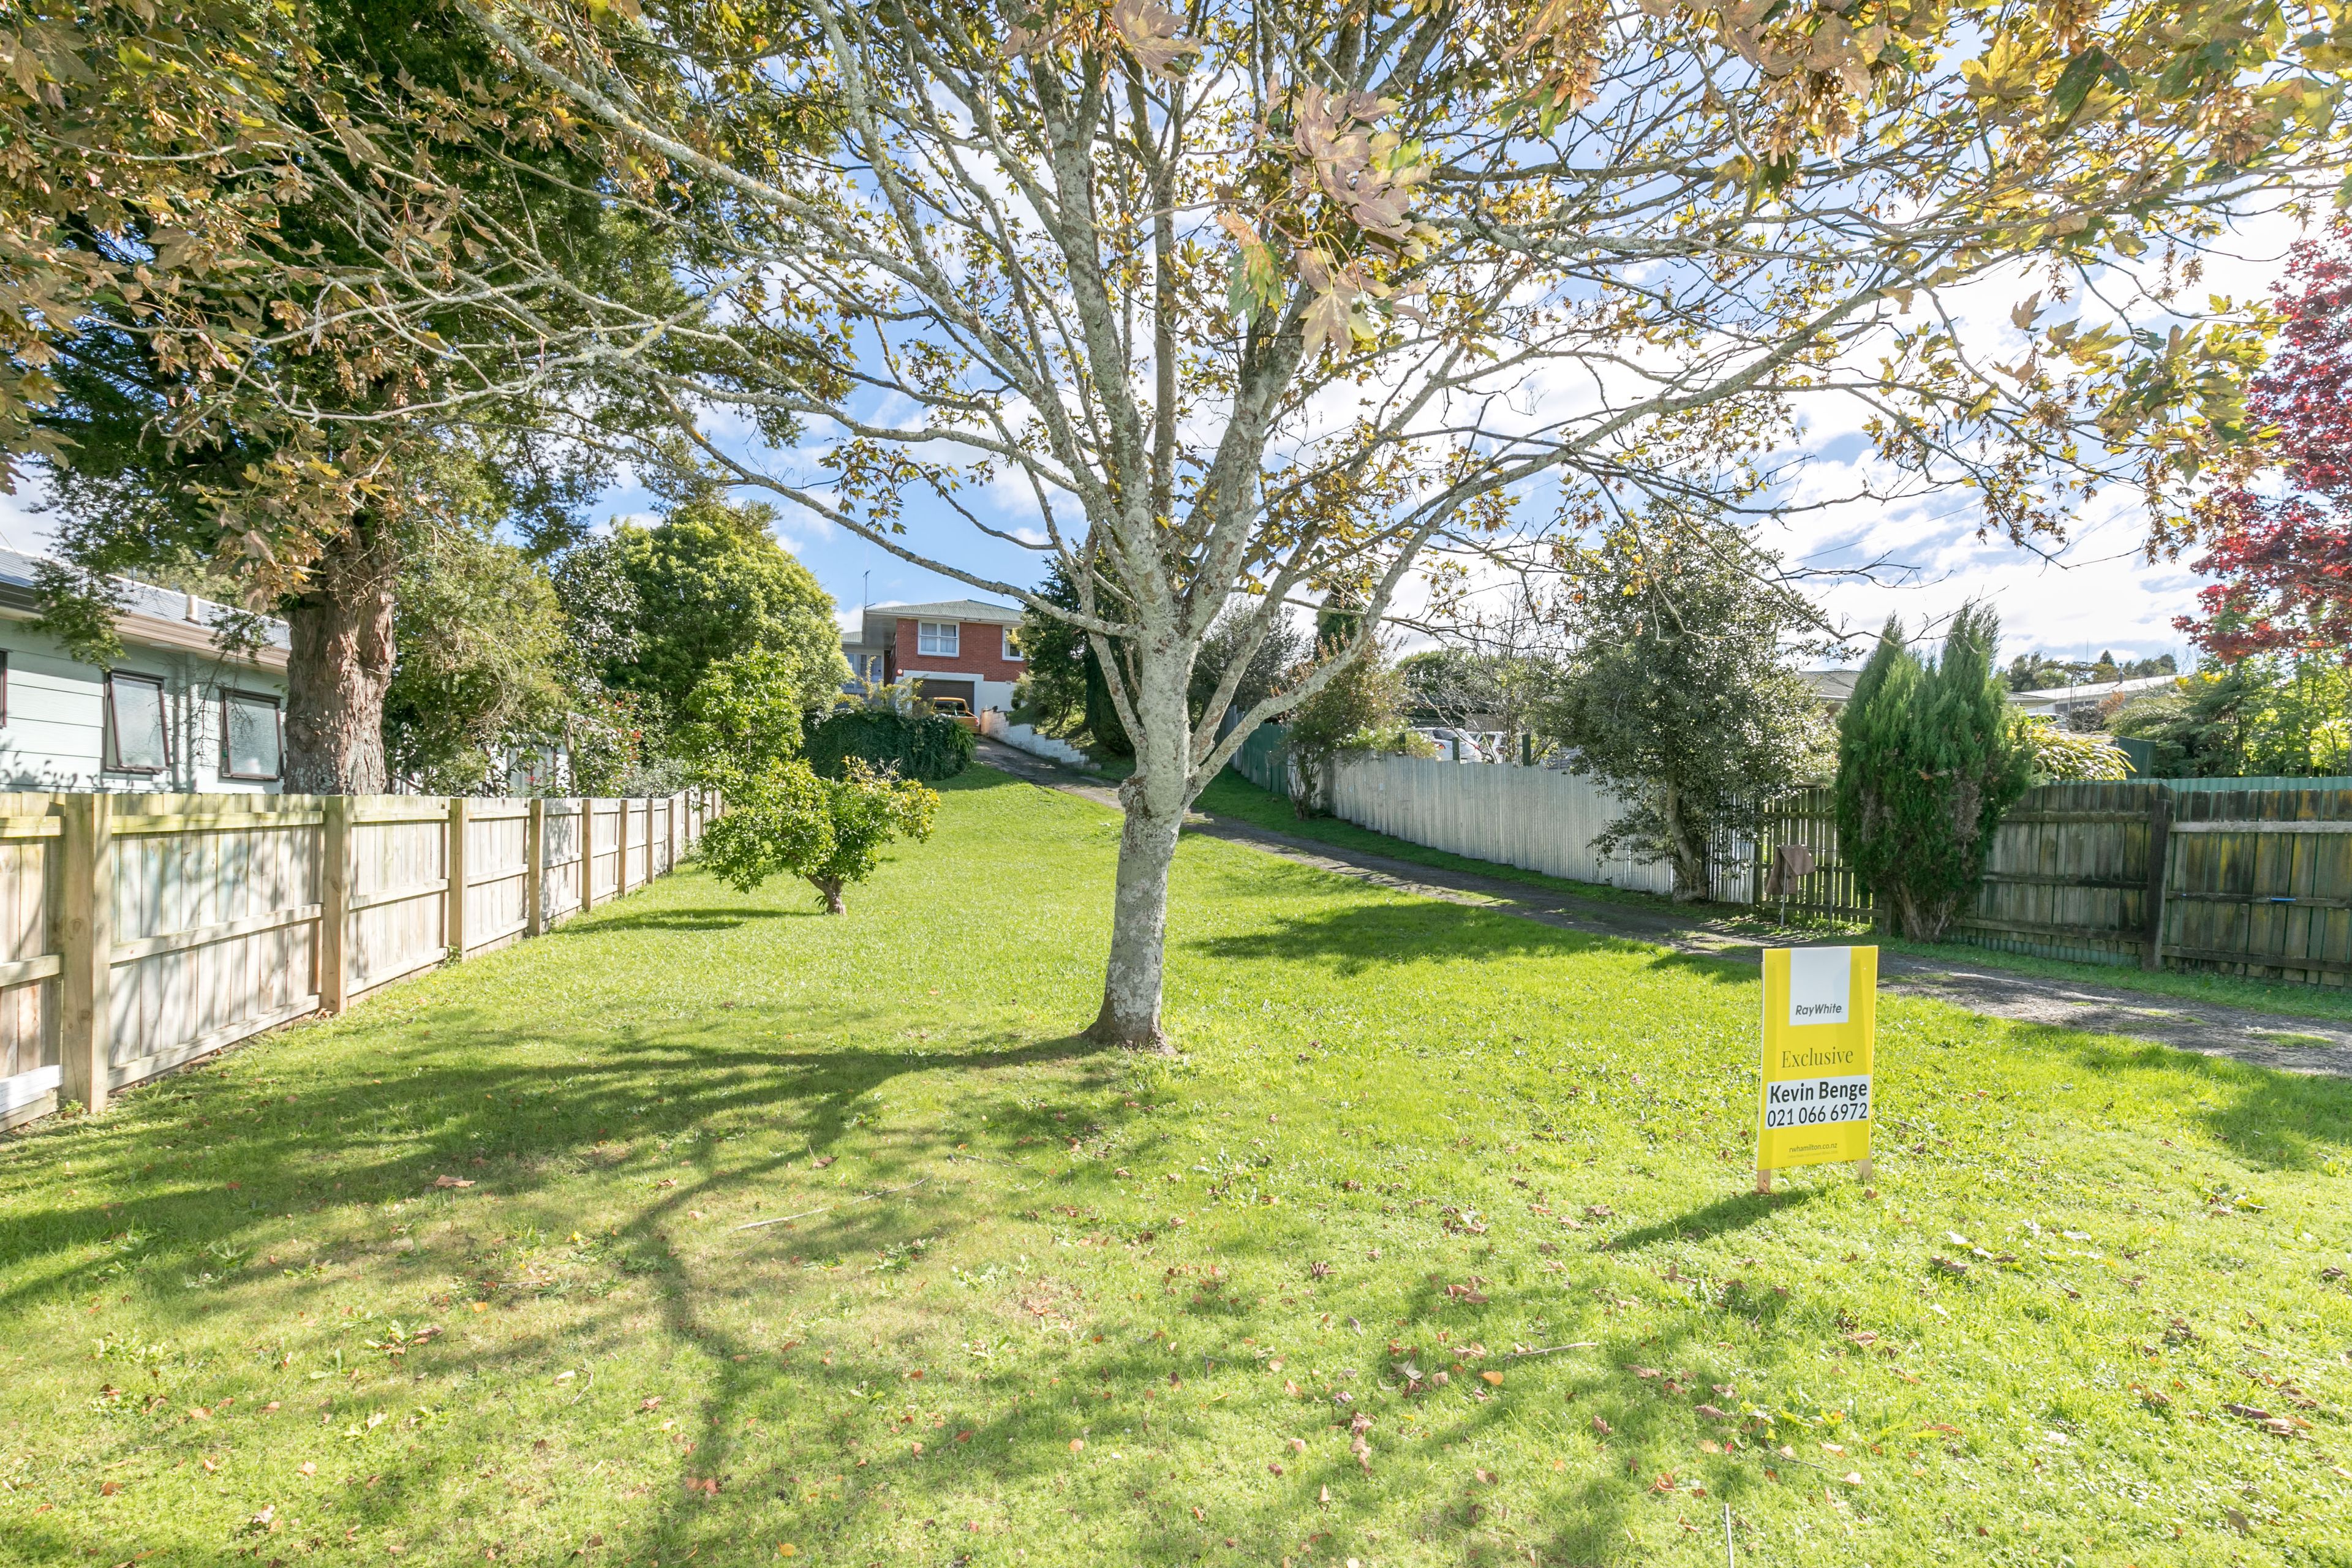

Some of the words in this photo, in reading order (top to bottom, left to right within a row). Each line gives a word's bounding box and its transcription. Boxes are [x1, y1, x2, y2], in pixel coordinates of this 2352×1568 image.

[1781, 1046, 1853, 1068] Exclusive
[1770, 1083, 1814, 1104] Kevin
[1819, 1081, 1867, 1101] Benge
[1767, 1108, 1794, 1128] 021
[1798, 1105, 1826, 1124] 066
[1830, 1102, 1868, 1121] 6972
[1789, 1143, 1838, 1153] rwhamilton.co.nz
